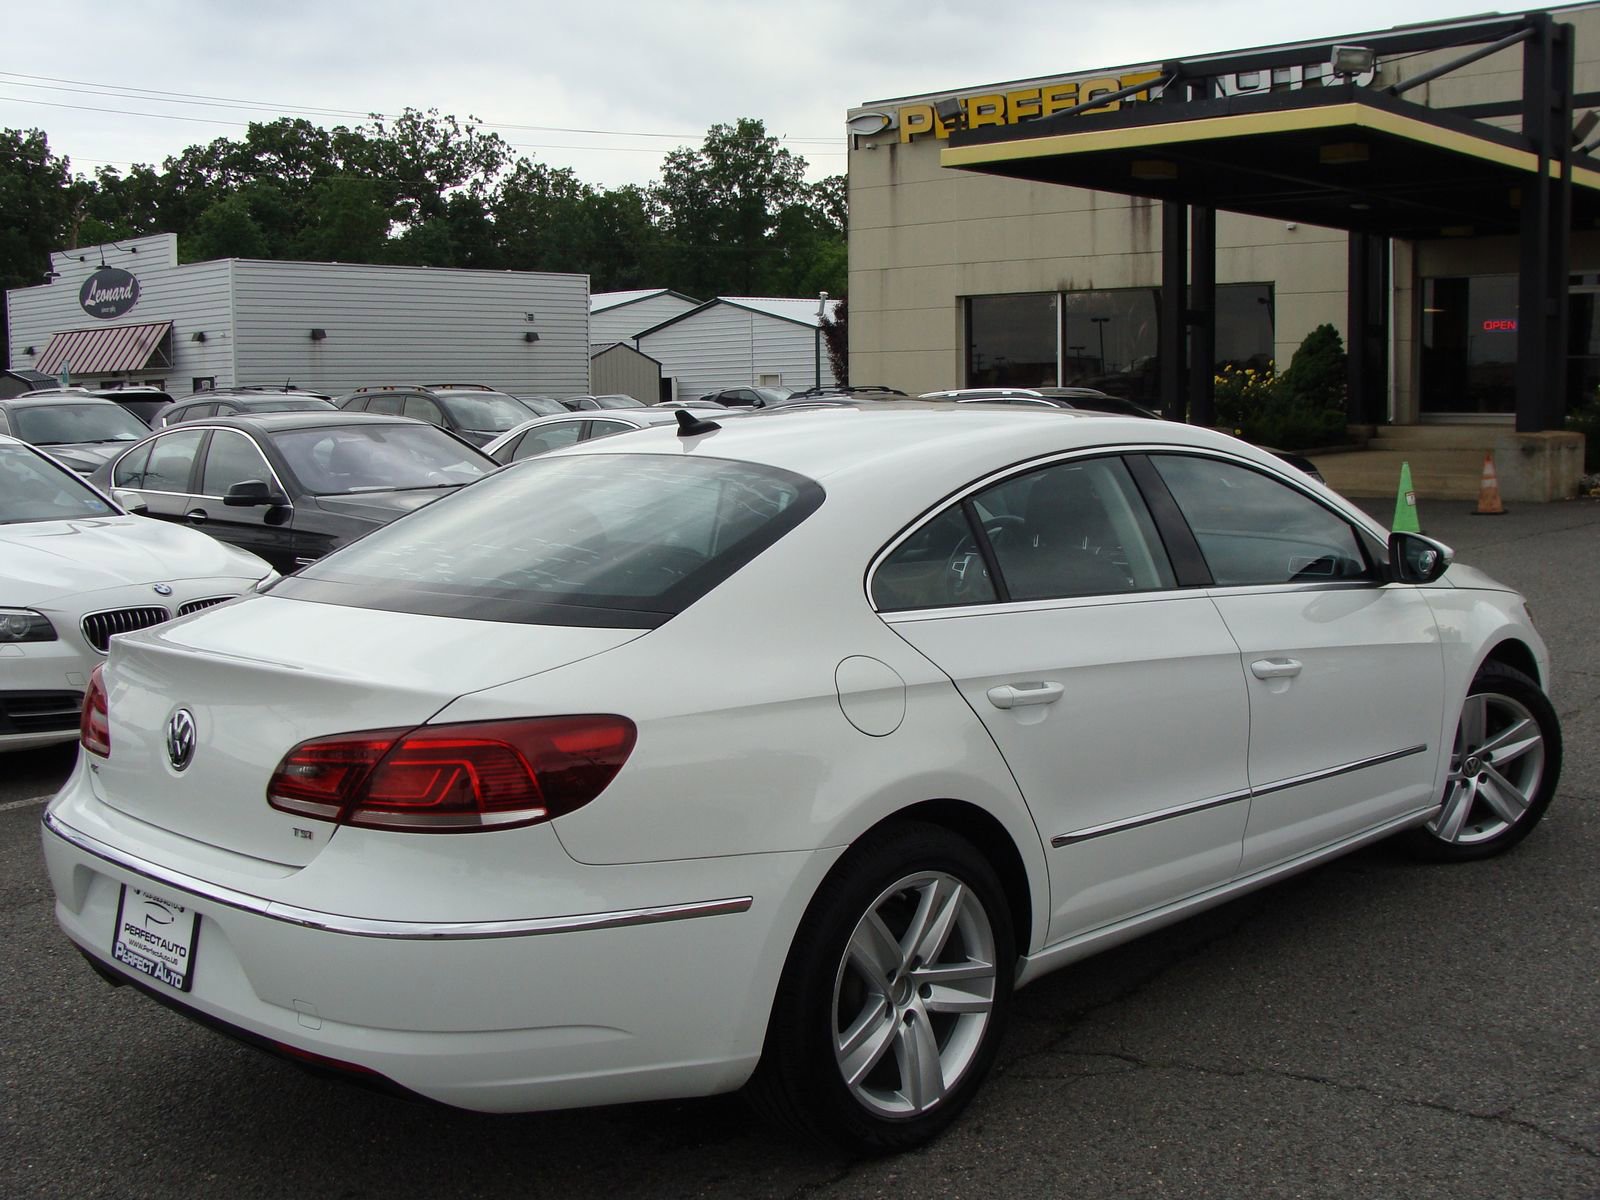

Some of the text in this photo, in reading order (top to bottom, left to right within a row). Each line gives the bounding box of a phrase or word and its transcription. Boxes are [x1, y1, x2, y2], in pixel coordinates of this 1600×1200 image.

[85, 278, 134, 306] Leonard
[1483, 320, 1517, 330] OPEN
[292, 827, 313, 840] TSI
